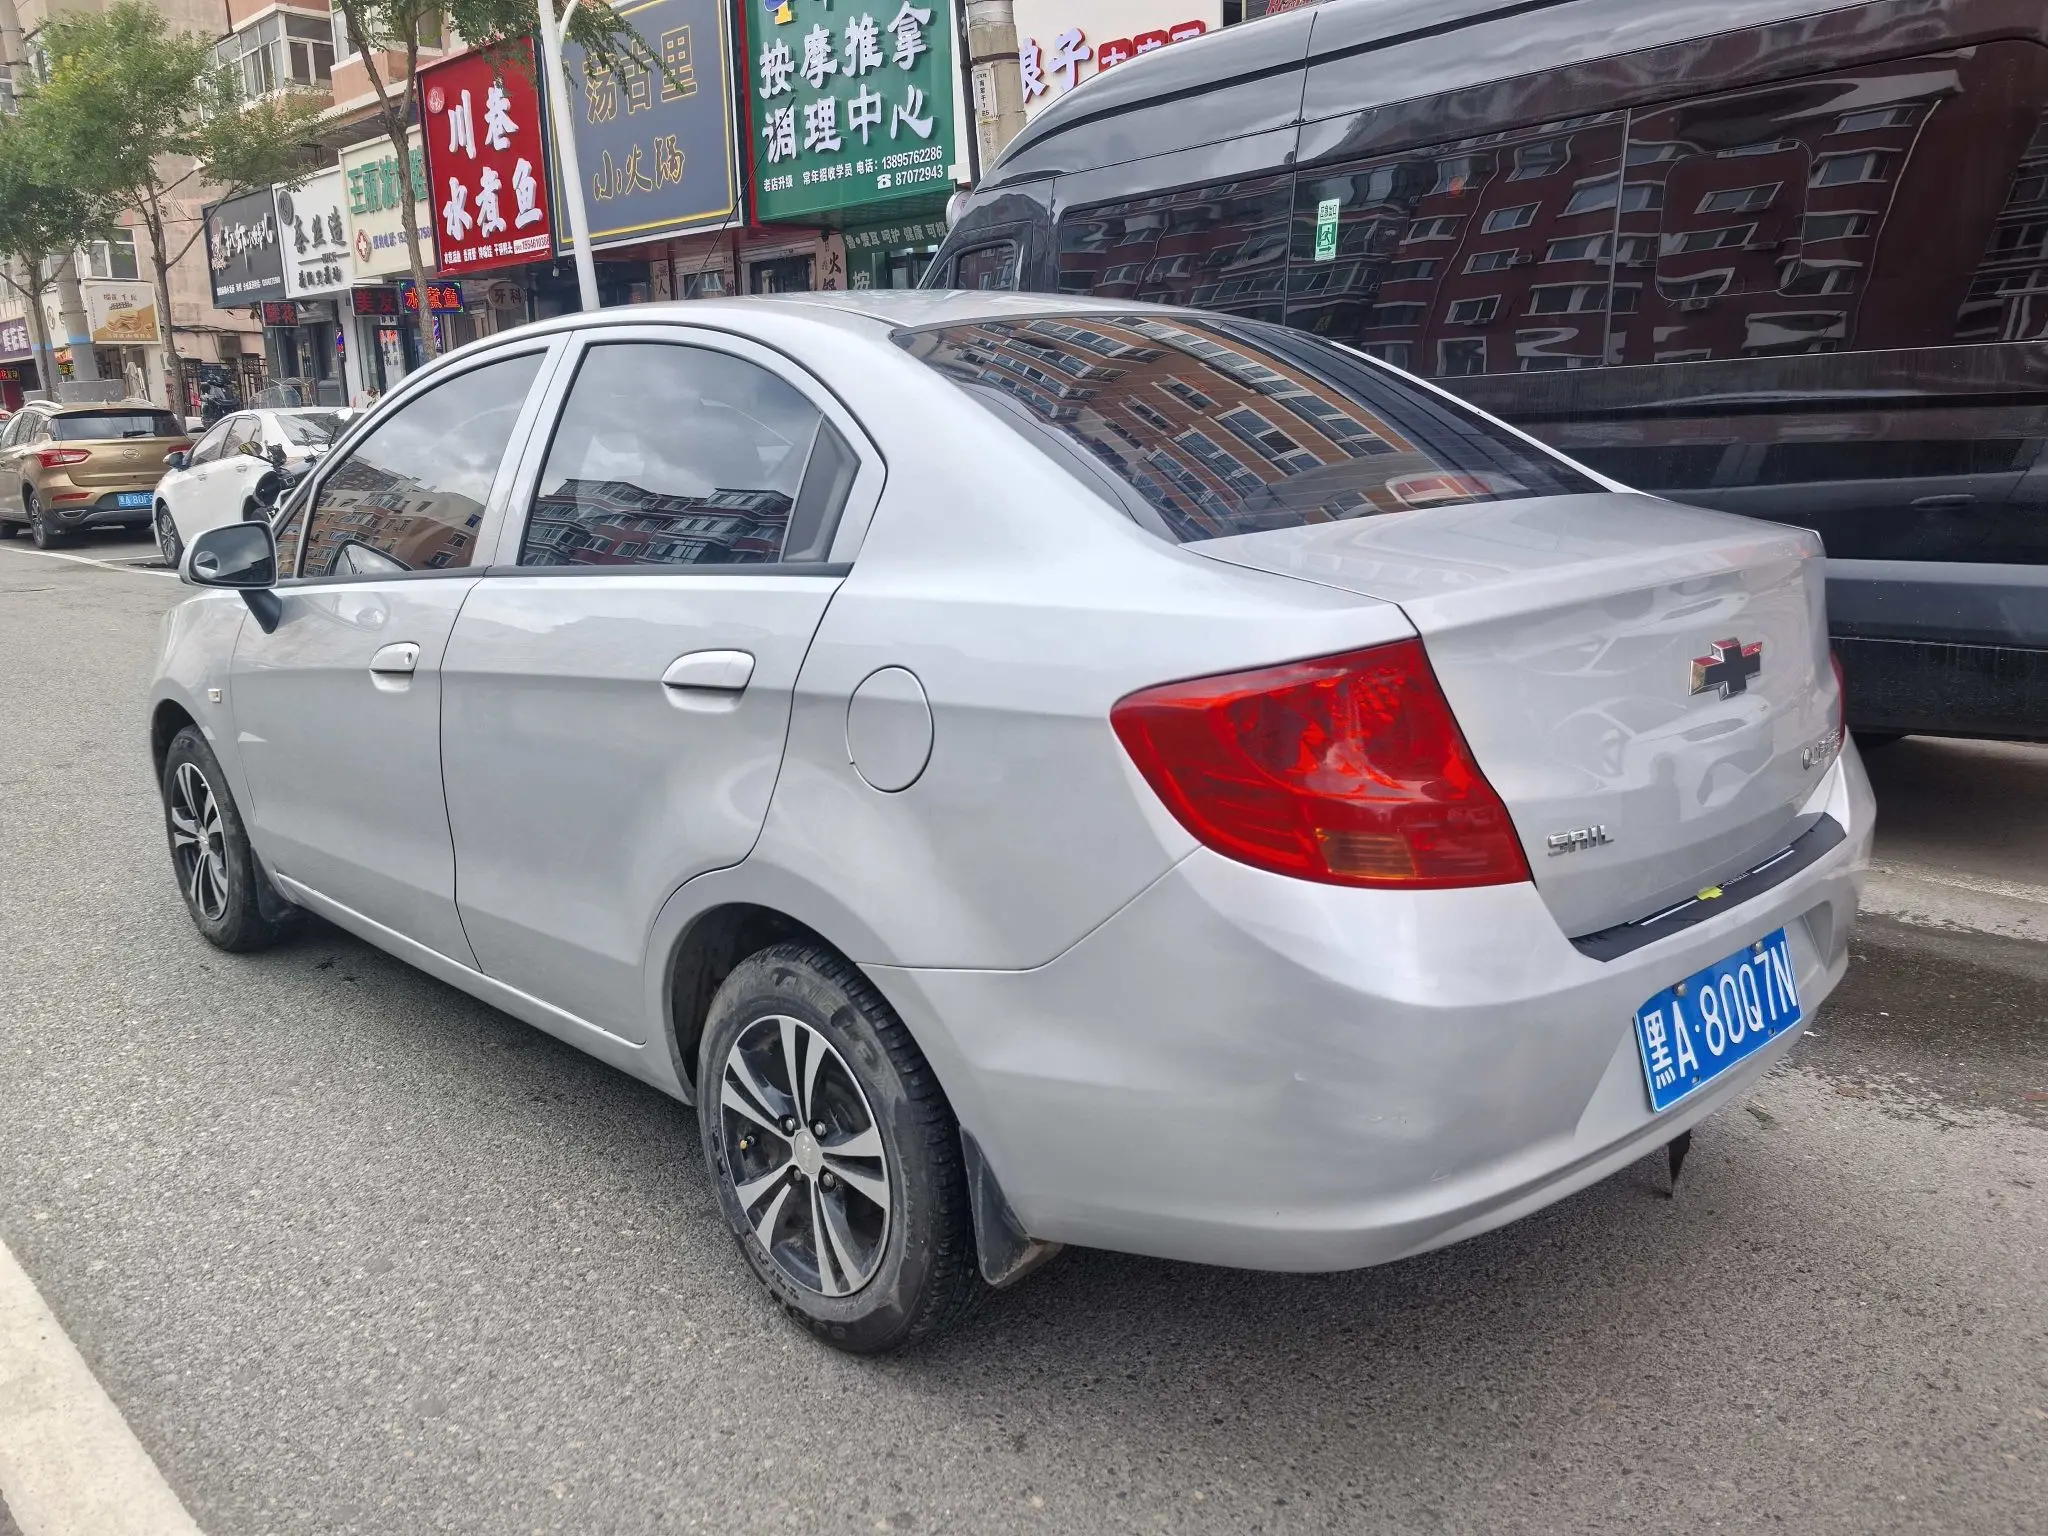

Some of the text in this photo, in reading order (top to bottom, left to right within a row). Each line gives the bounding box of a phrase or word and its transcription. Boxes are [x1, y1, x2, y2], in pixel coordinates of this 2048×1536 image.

[759, 1, 931, 99] 按摩推拿
[762, 84, 933, 163] 调理中心
[594, 134, 686, 201] 小火锅
[763, 174, 794, 193] 老店升级
[802, 162, 853, 186] 常年招收学员
[881, 145, 943, 170] 13895762286
[895, 164, 943, 186] 87072943
[442, 157, 543, 241] 水煮鱼
[903, 224, 924, 241] 健康
[926, 221, 951, 238] 可视
[355, 288, 396, 313] 美发
[494, 287, 521, 304] 牙科
[265, 303, 297, 323] 鲜花
[1547, 824, 1615, 857] SAIL
